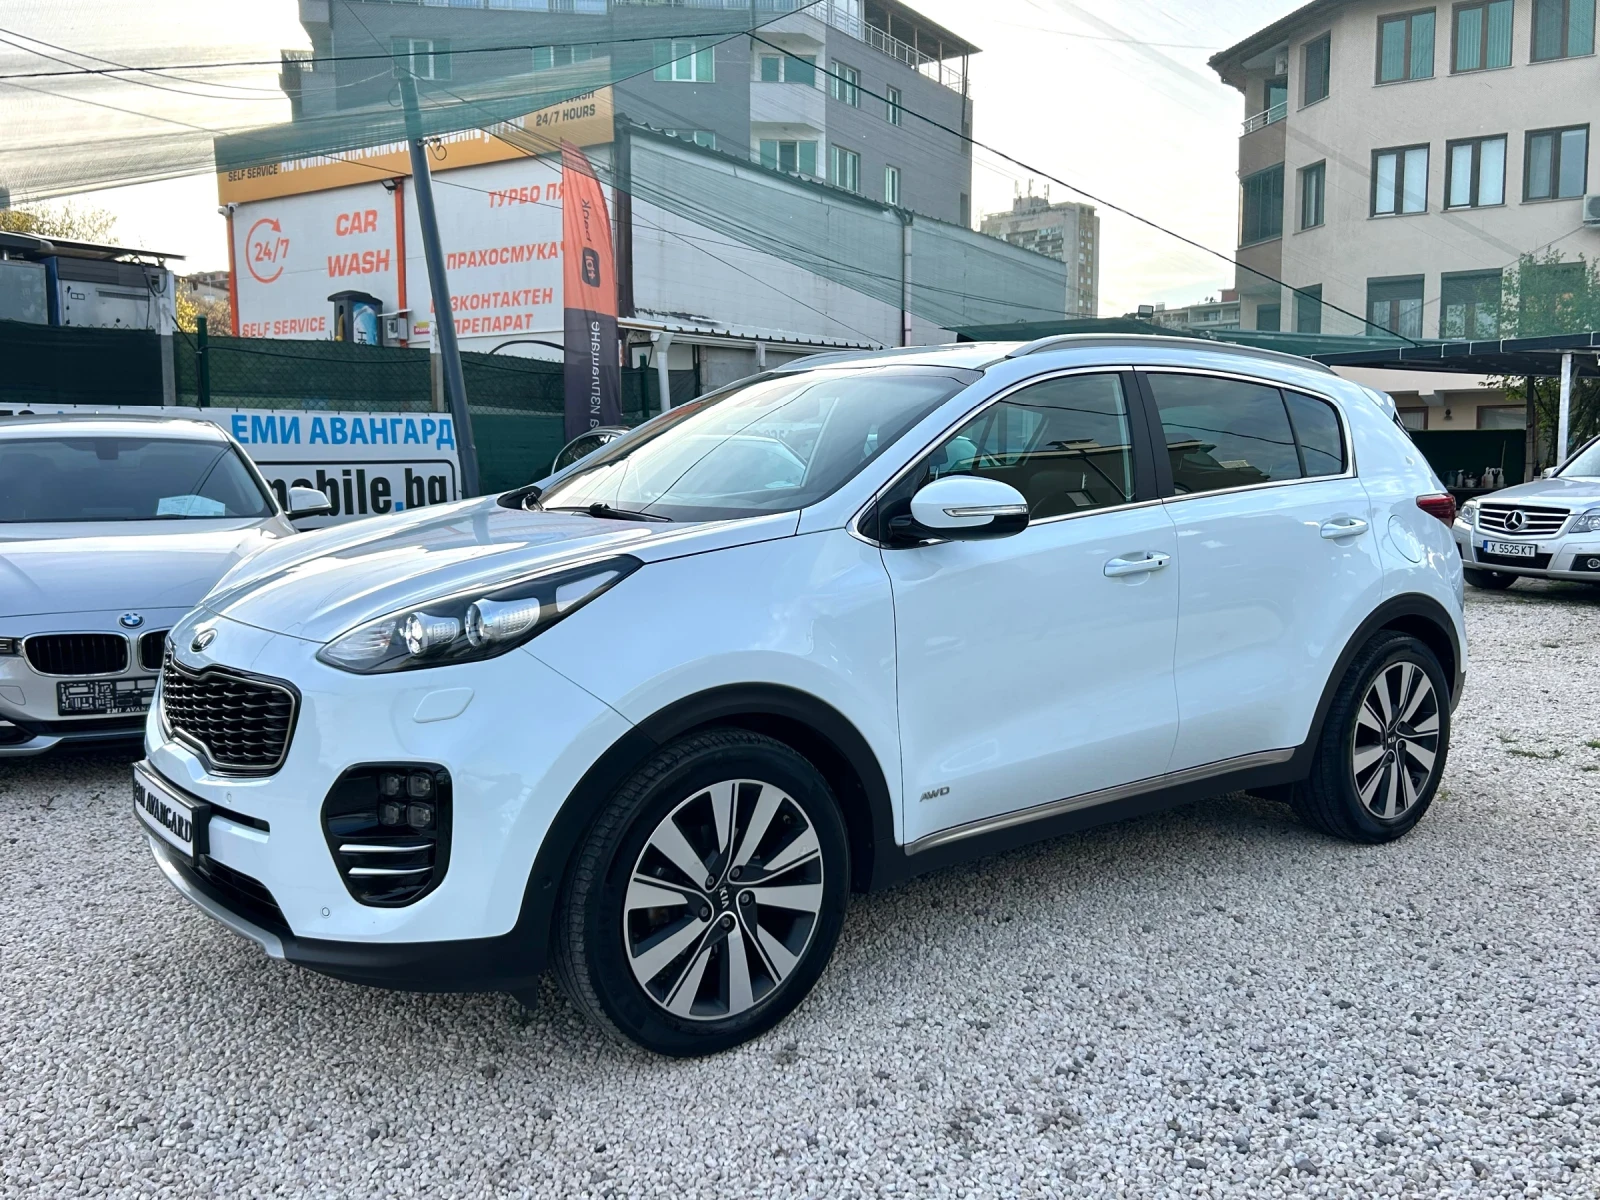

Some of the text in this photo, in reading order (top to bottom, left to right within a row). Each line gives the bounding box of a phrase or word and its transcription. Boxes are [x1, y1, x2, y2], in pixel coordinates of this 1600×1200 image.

[536, 103, 596, 127] 24/7 HOURS
[228, 164, 278, 182] SELF SERVICE
[488, 185, 541, 209] ТУРБО
[335, 209, 378, 237] CAR
[254, 237, 290, 263] 24/7
[327, 249, 391, 278] WASH
[430, 287, 553, 314] ЗКОНТАКТЕН
[242, 316, 326, 338] SELF SERVICE
[231, 414, 455, 451] ЕМИ АВАНГАРД
[1499, 543, 1520, 555] 5525
[1520, 545, 1534, 556] KT
[919, 785, 950, 803] AWD
[145, 791, 193, 843] AVANGARD
